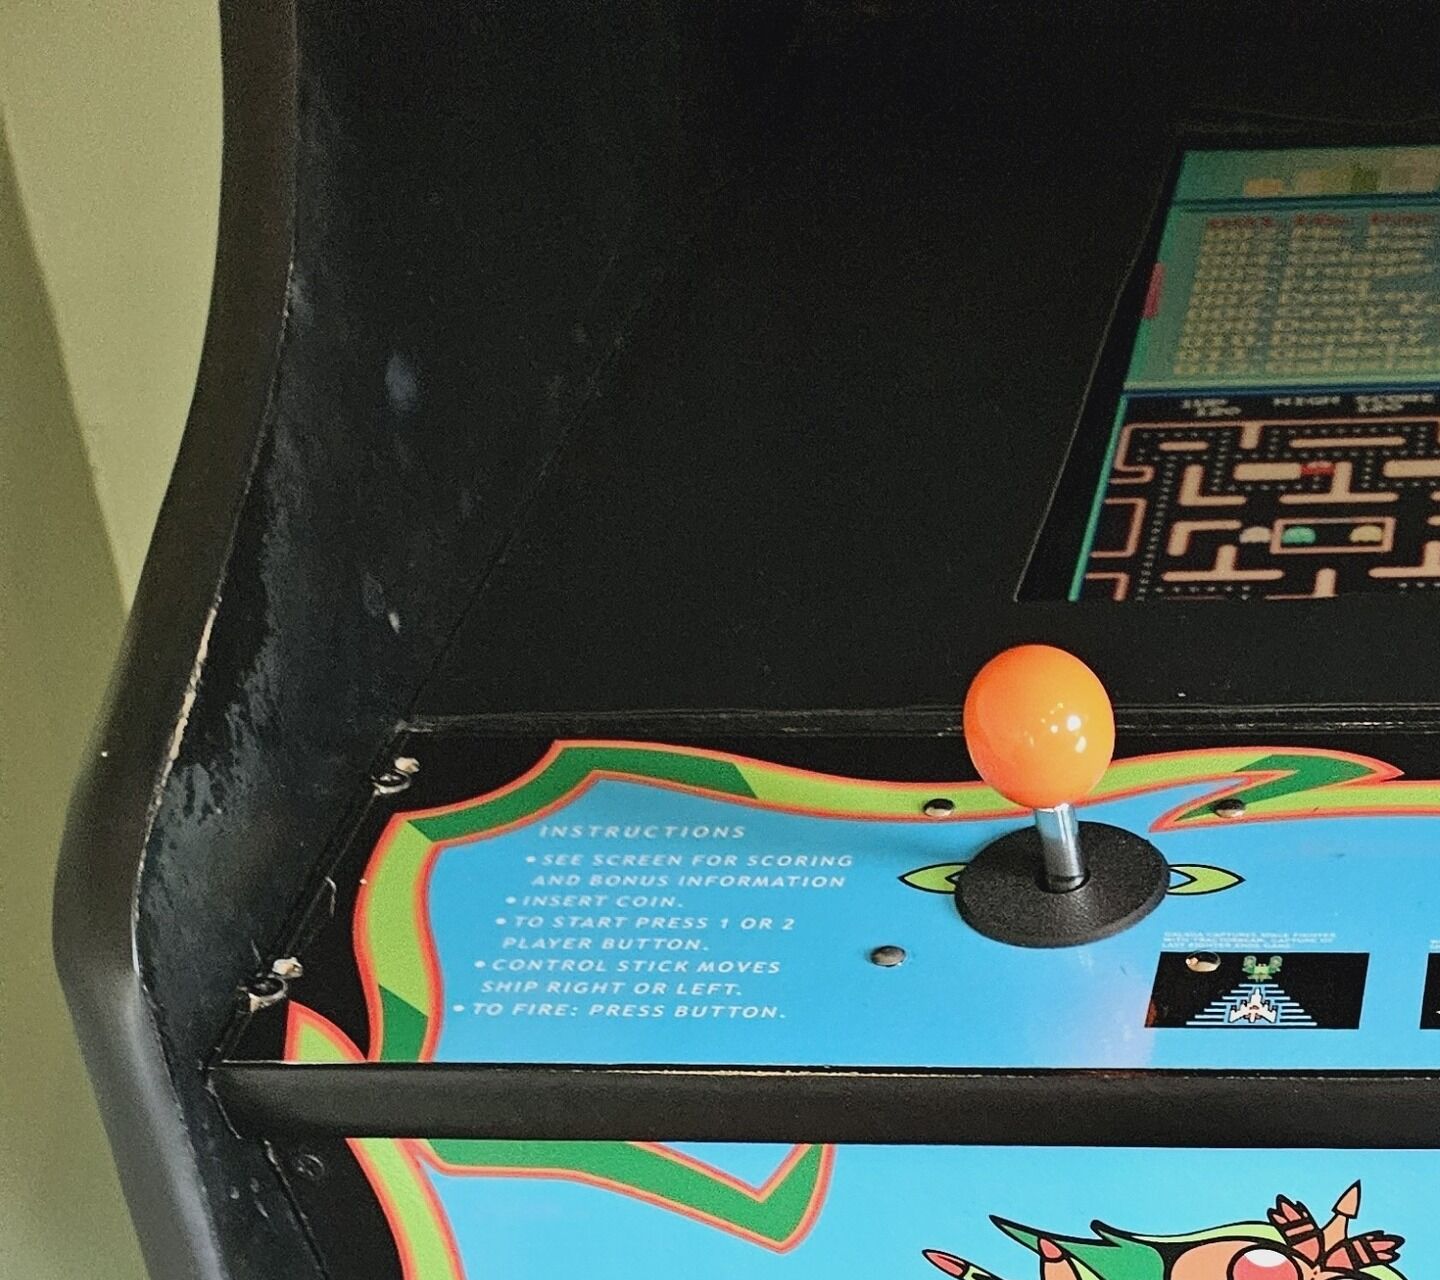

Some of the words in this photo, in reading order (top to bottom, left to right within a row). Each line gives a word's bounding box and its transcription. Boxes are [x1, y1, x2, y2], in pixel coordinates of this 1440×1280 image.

[538, 826, 746, 839] INSTRUCTIONS
[542, 855, 583, 866] SEE
[592, 854, 682, 867] SCREEN
[692, 855, 738, 867] FOR
[746, 855, 853, 867] SCORING
[531, 875, 580, 887] AND
[589, 875, 669, 887] BONUS
[678, 875, 845, 888] INFORMATION
[522, 896, 606, 908] INSERT
[616, 896, 684, 908] COIN.
[514, 916, 544, 928] TO
[552, 916, 627, 929] START
[635, 917, 708, 929] PRESS
[720, 918, 728, 929] 1
[740, 918, 772, 930] OR
[782, 918, 795, 930] 2
[502, 937, 592, 950] PLAYER
[601, 937, 709, 951] BUTTON.
[491, 959, 611, 972] CONTROL
[617, 960, 688, 973] STICK
[695, 961, 781, 974] MOVES
[481, 980, 538, 993] SHIP
[547, 981, 625, 995] RIGHT
[633, 982, 667, 995] OR
[676, 983, 743, 996] LEFT.
[472, 1003, 503, 1017] TO
[512, 1003, 579, 1017] FIRE:
[588, 1004, 664, 1018] PRESS
[674, 1005, 787, 1019] BUTTON.
